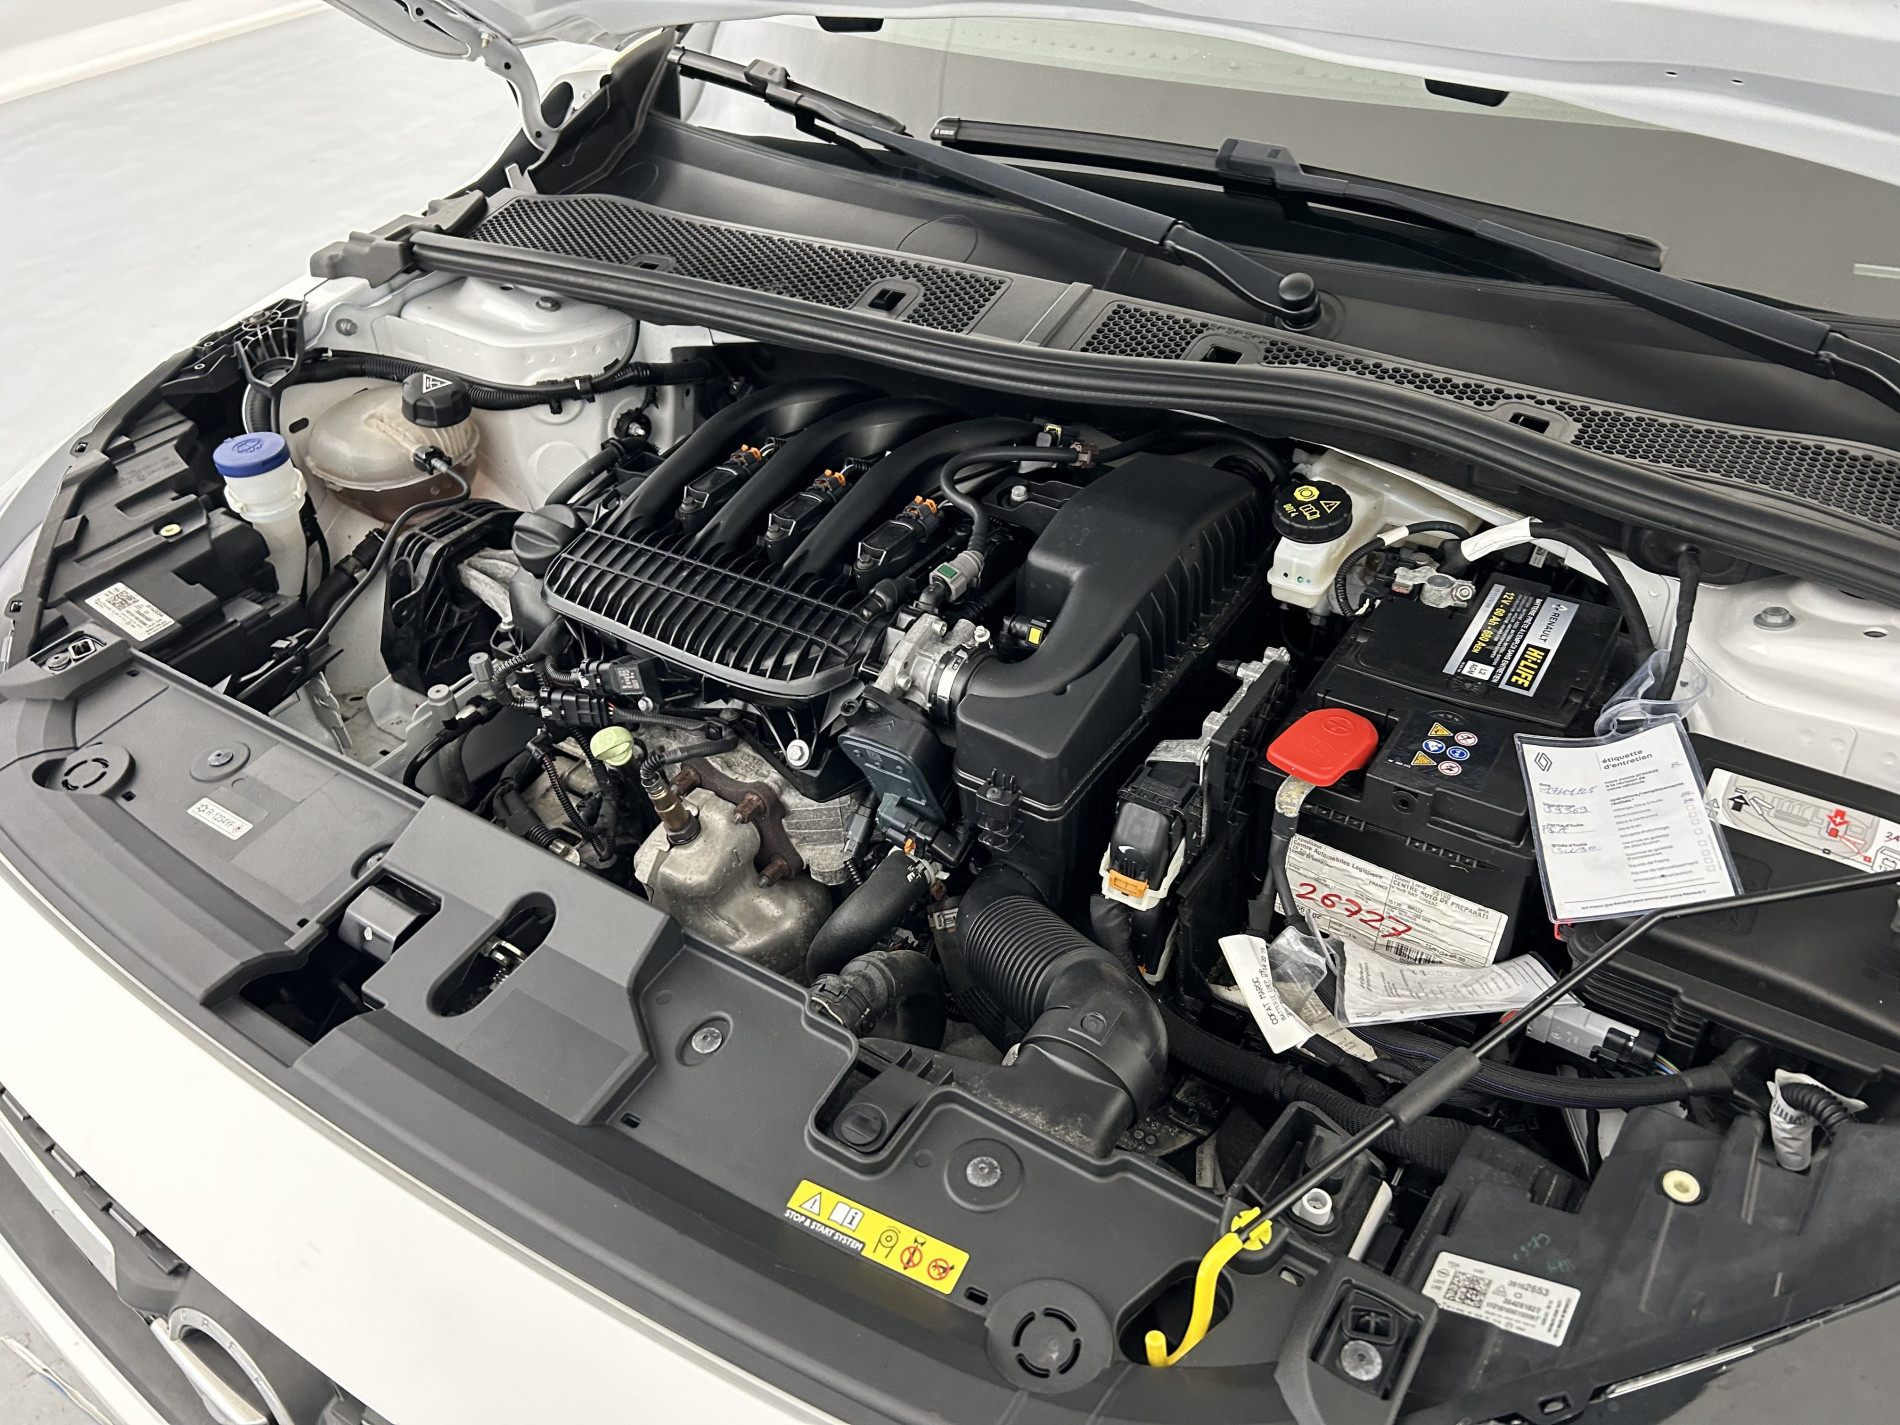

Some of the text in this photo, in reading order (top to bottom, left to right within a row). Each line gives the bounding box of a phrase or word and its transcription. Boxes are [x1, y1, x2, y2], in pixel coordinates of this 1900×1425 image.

[1527, 597, 1542, 616] BATTERIE
[1538, 612, 1560, 642] RENAULT
[1502, 648, 1514, 660] SANS
[1466, 662, 1477, 674] AGM
[1477, 667, 1487, 675] L2
[1602, 749, 1643, 765] étiquette
[1603, 753, 1653, 770] d'entretien
[1293, 840, 1313, 852] Centre
[1313, 848, 1350, 867] Automobiles
[1295, 882, 1412, 939] 26727
[1393, 880, 1418, 893] CENTRE
[1421, 890, 1438, 902] AUTO
[1440, 897, 1449, 905] DE
[1450, 900, 1489, 920] PREPARATI
[1251, 977, 1267, 1000] MAROC
[784, 1209, 806, 1223] STOP
[809, 1221, 835, 1238] START
[833, 1231, 864, 1251] SYSTEM
